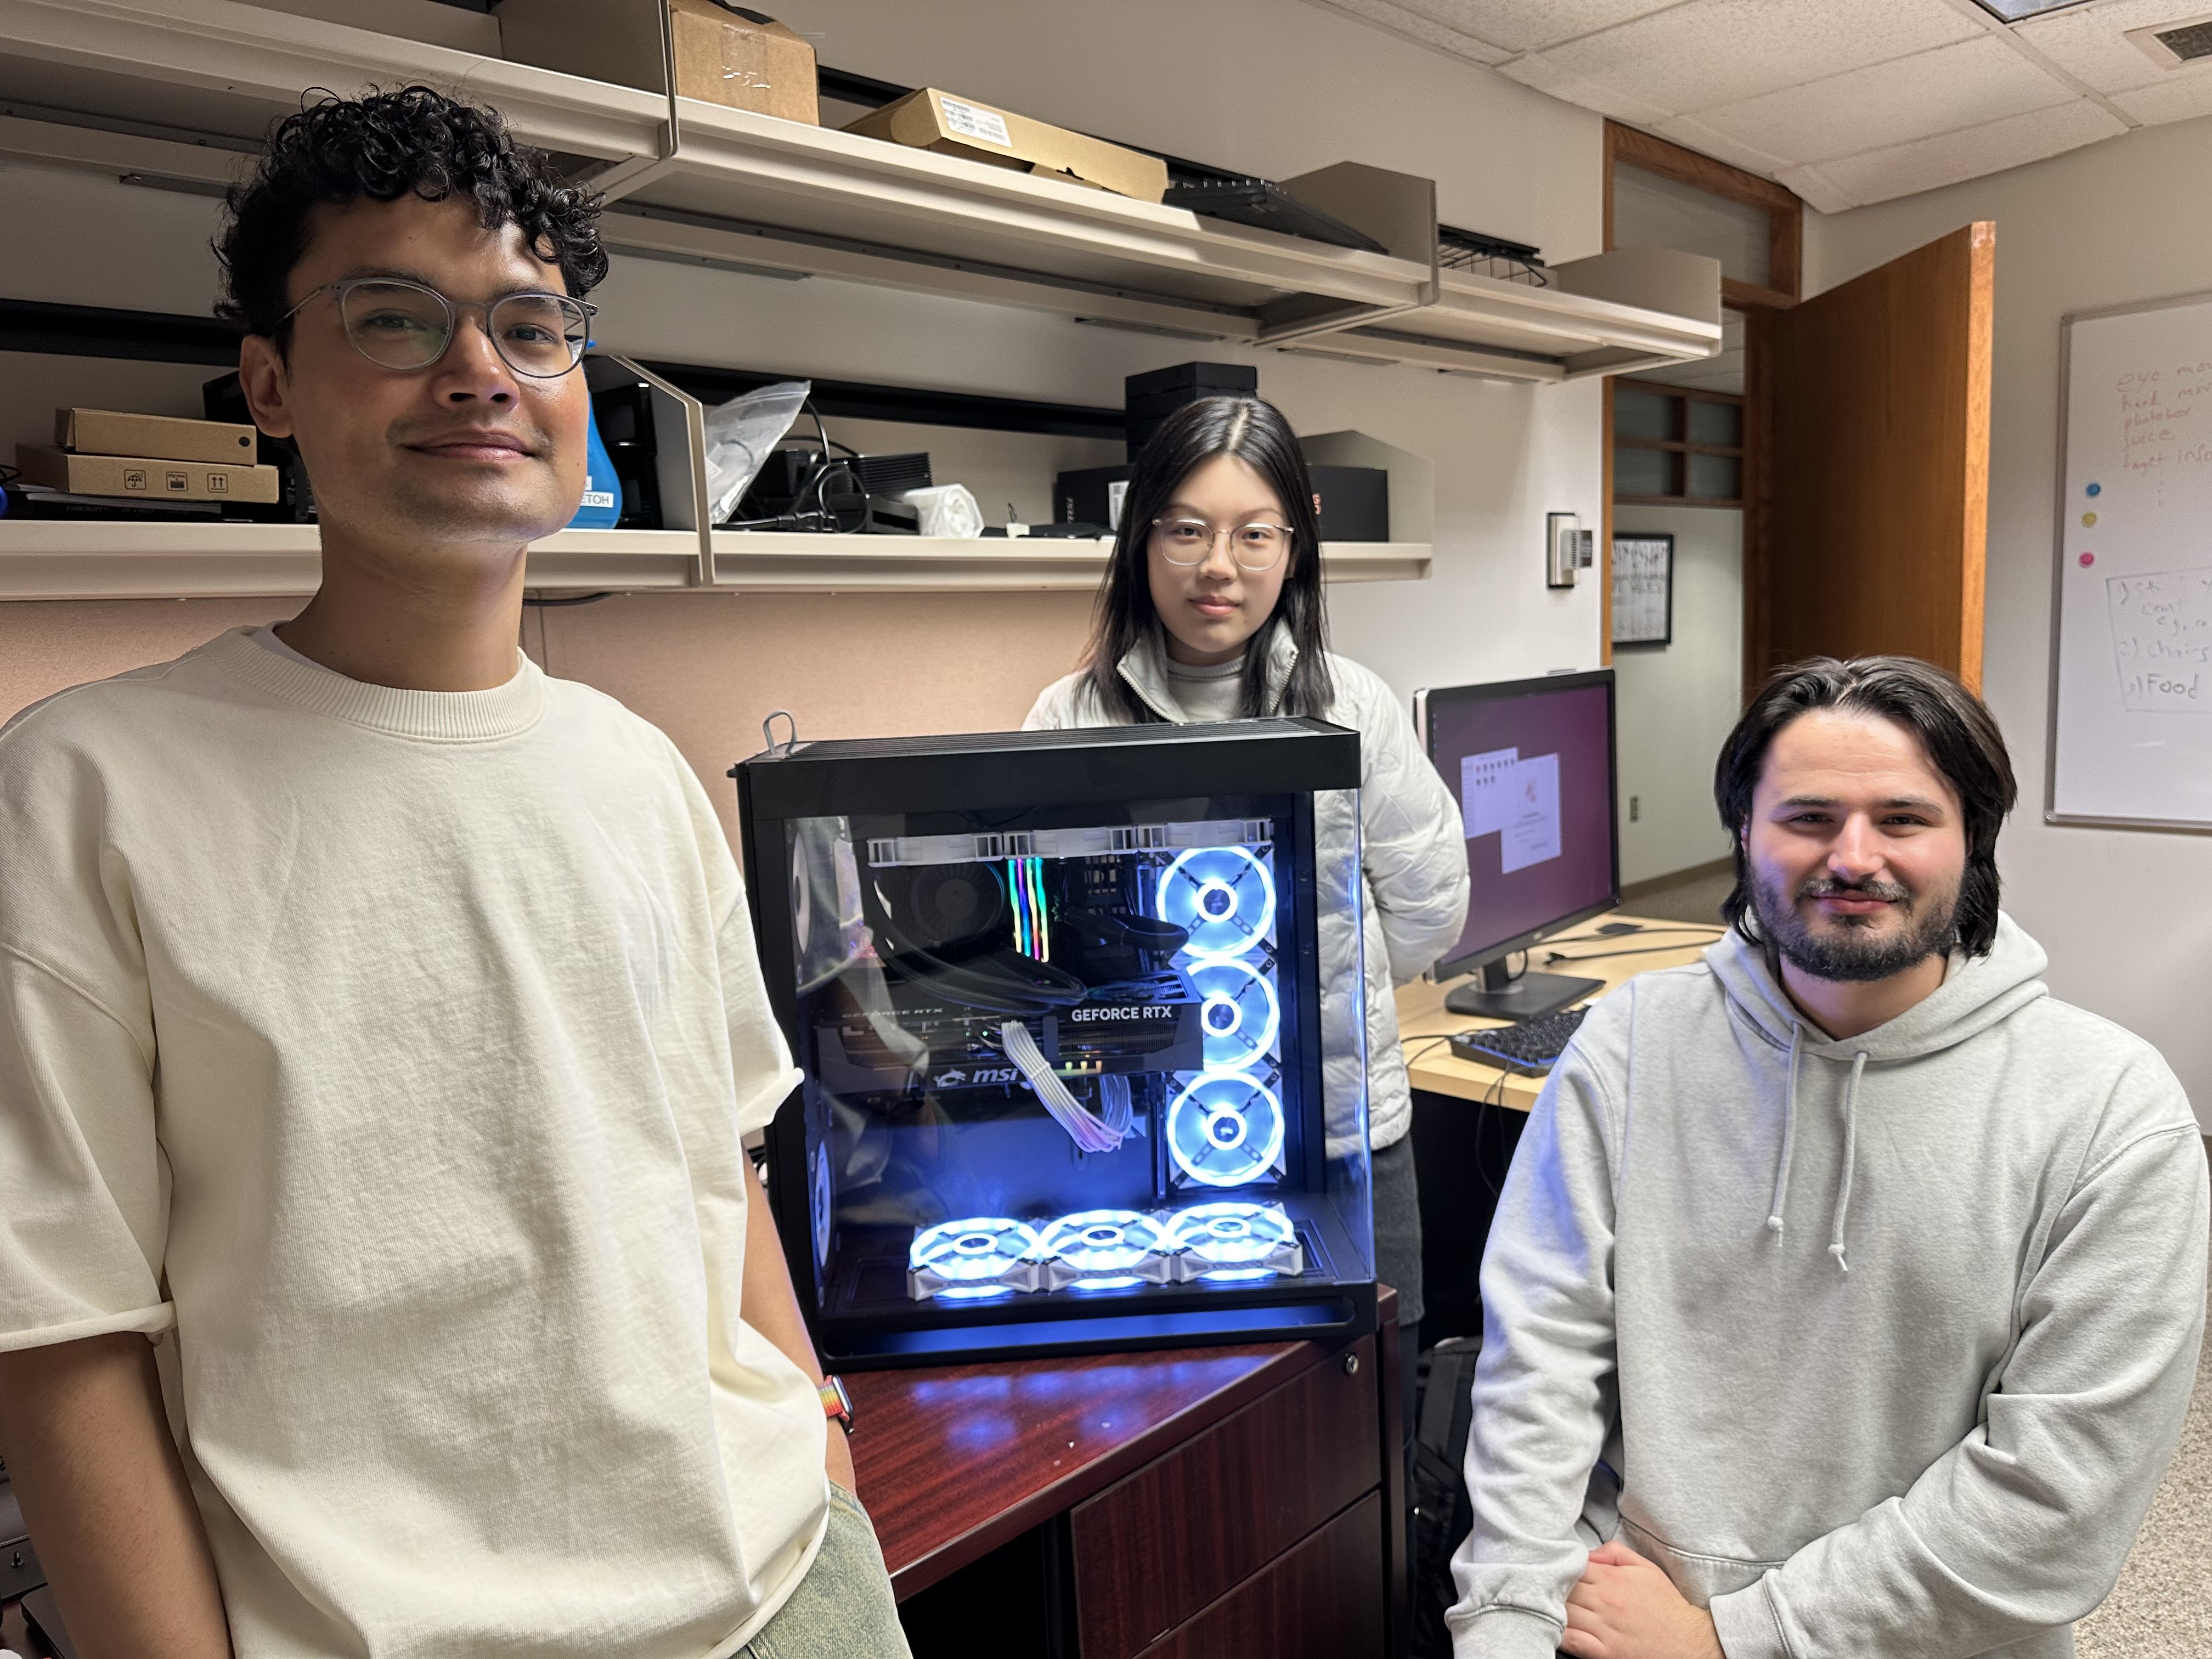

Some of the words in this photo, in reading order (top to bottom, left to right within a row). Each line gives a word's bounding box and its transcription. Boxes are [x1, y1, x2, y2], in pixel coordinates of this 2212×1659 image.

[2146, 672, 2199, 700] Food
[1071, 1007, 1139, 1022] GEFORCE
[1143, 1005, 1172, 1019] RTX
[972, 1068, 1018, 1084] msi
